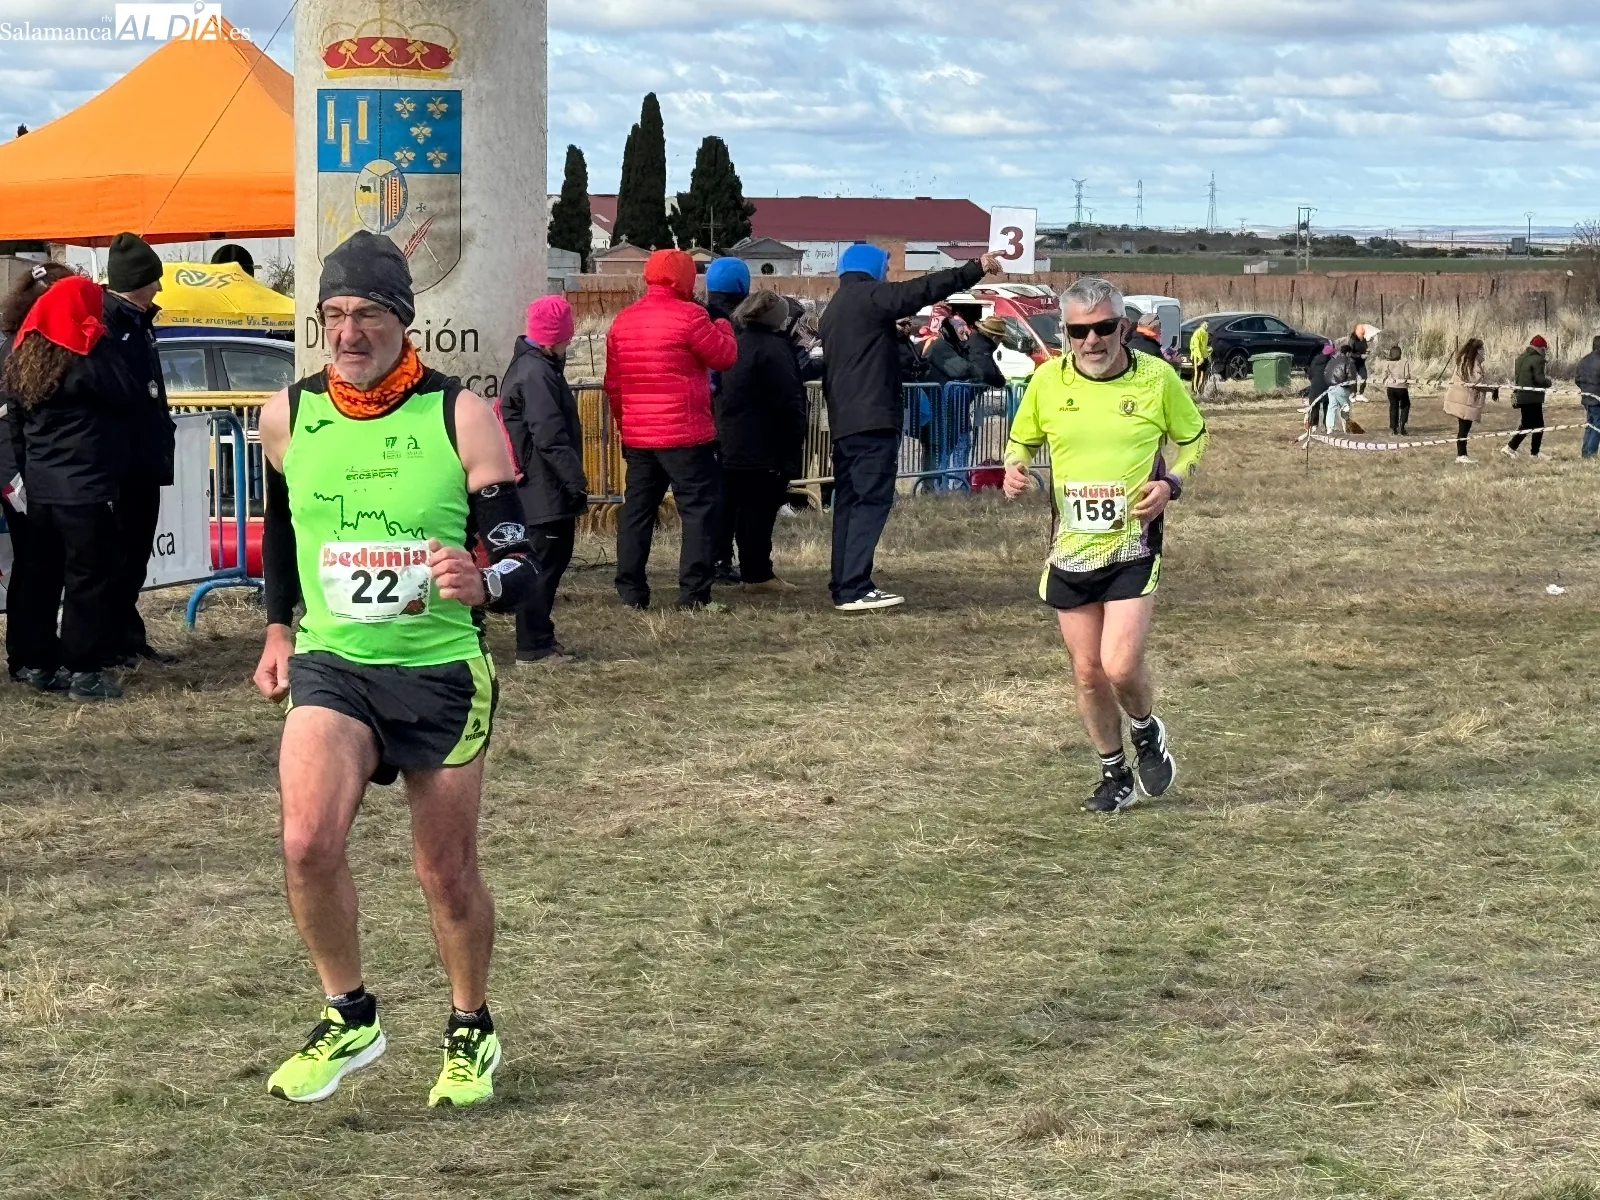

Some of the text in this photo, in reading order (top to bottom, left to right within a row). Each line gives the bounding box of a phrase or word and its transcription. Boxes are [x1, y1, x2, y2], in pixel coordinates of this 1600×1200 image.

[1000, 226, 1024, 260] 3
[306, 316, 479, 352] Dición
[1073, 499, 1116, 521] 158
[351, 569, 399, 604] 22
